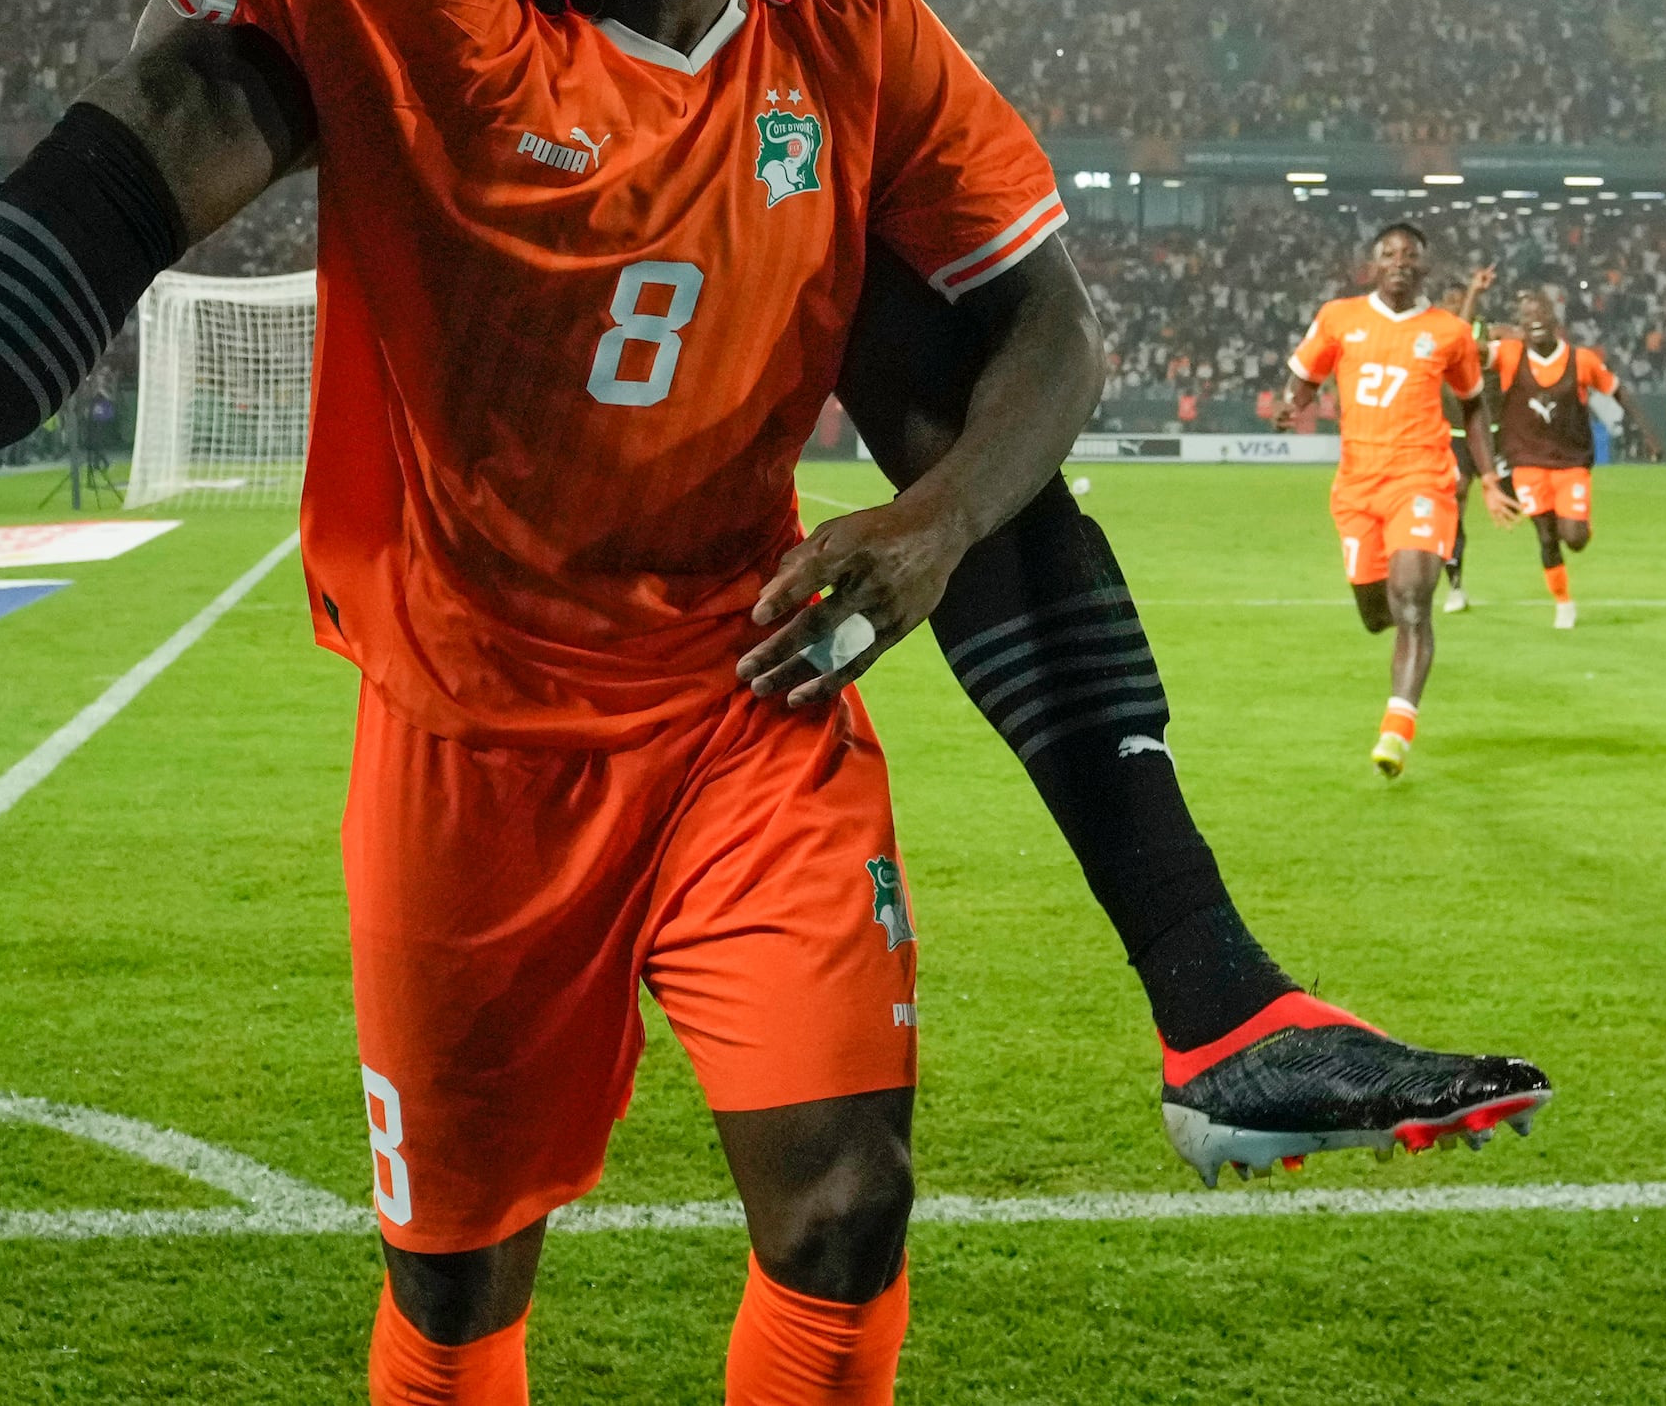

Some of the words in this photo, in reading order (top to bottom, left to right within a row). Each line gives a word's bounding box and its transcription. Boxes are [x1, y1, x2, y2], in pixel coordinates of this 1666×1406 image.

[516, 131, 590, 175] PUMA
[586, 260, 705, 407] 8
[1355, 362, 1408, 408] 27
[1236, 440, 1290, 457] VISA
[361, 1063, 412, 1227] 8
